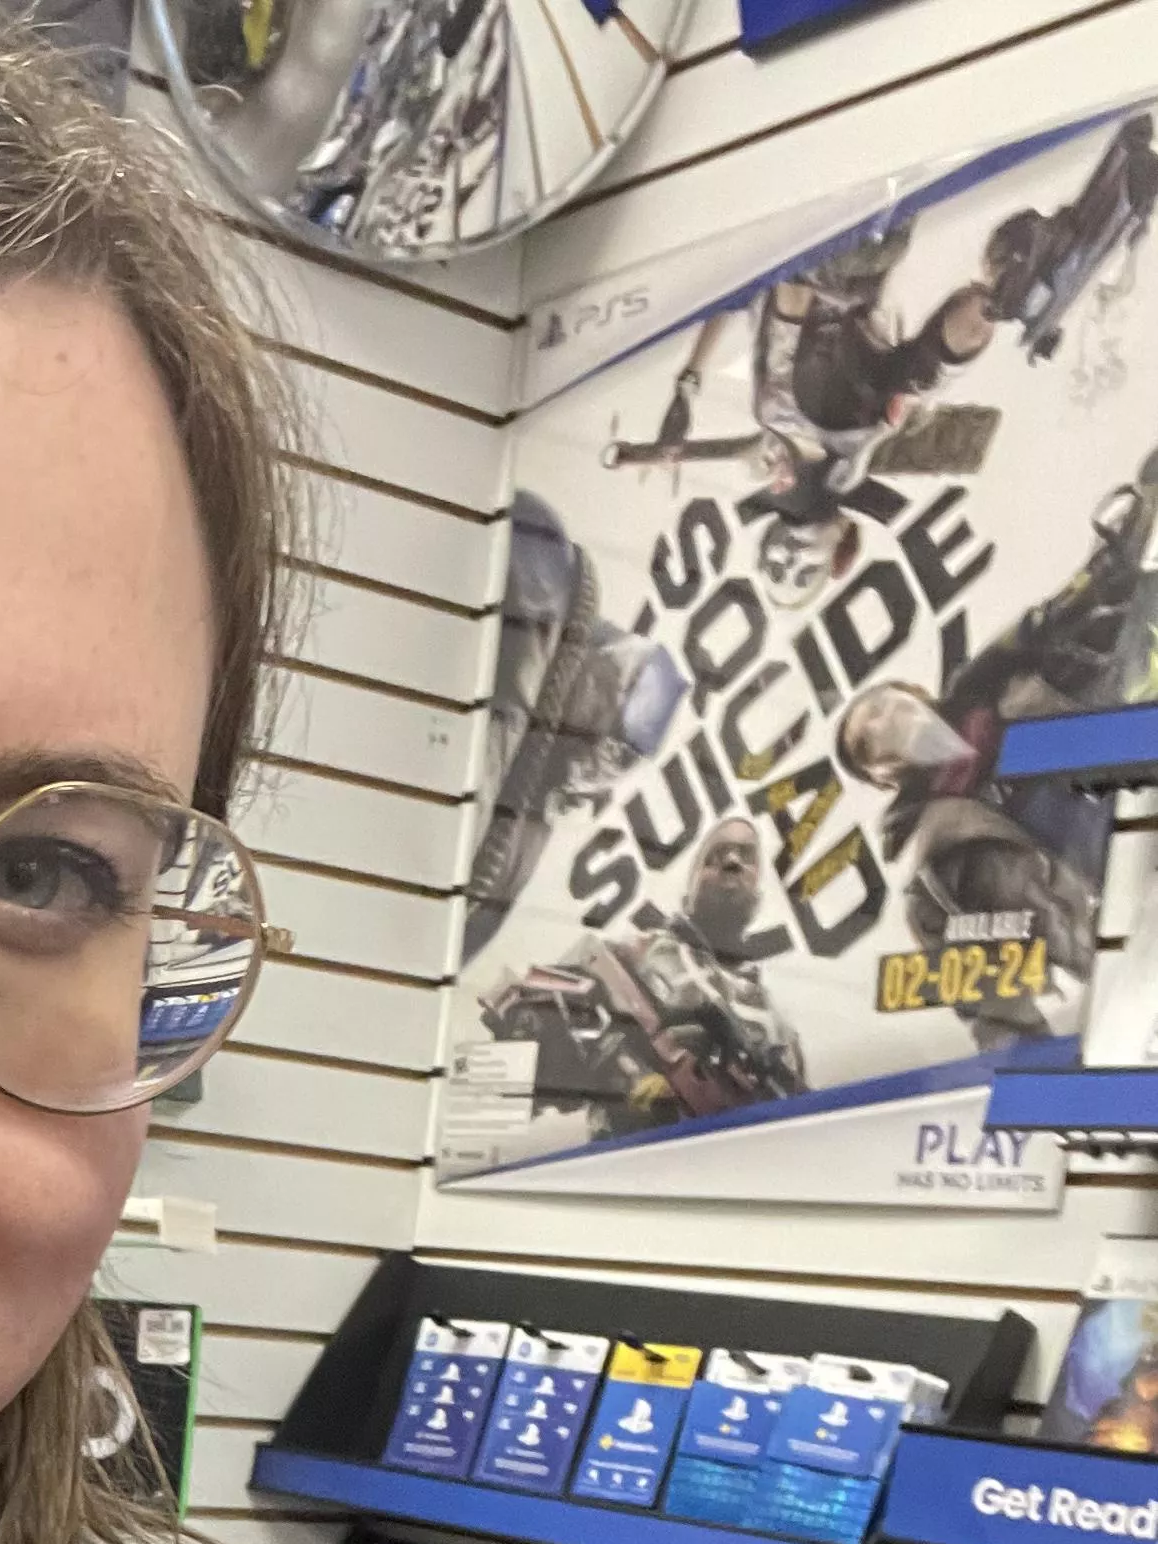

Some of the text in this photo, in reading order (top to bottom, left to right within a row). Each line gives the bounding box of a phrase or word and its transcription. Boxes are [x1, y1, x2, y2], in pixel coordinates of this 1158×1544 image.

[573, 285, 650, 335] PS5
[569, 486, 996, 929] SUICIDE
[883, 938, 1048, 1010] 02-02-24
[916, 1124, 1030, 1167] PLAY
[971, 1477, 1045, 1522] Get
